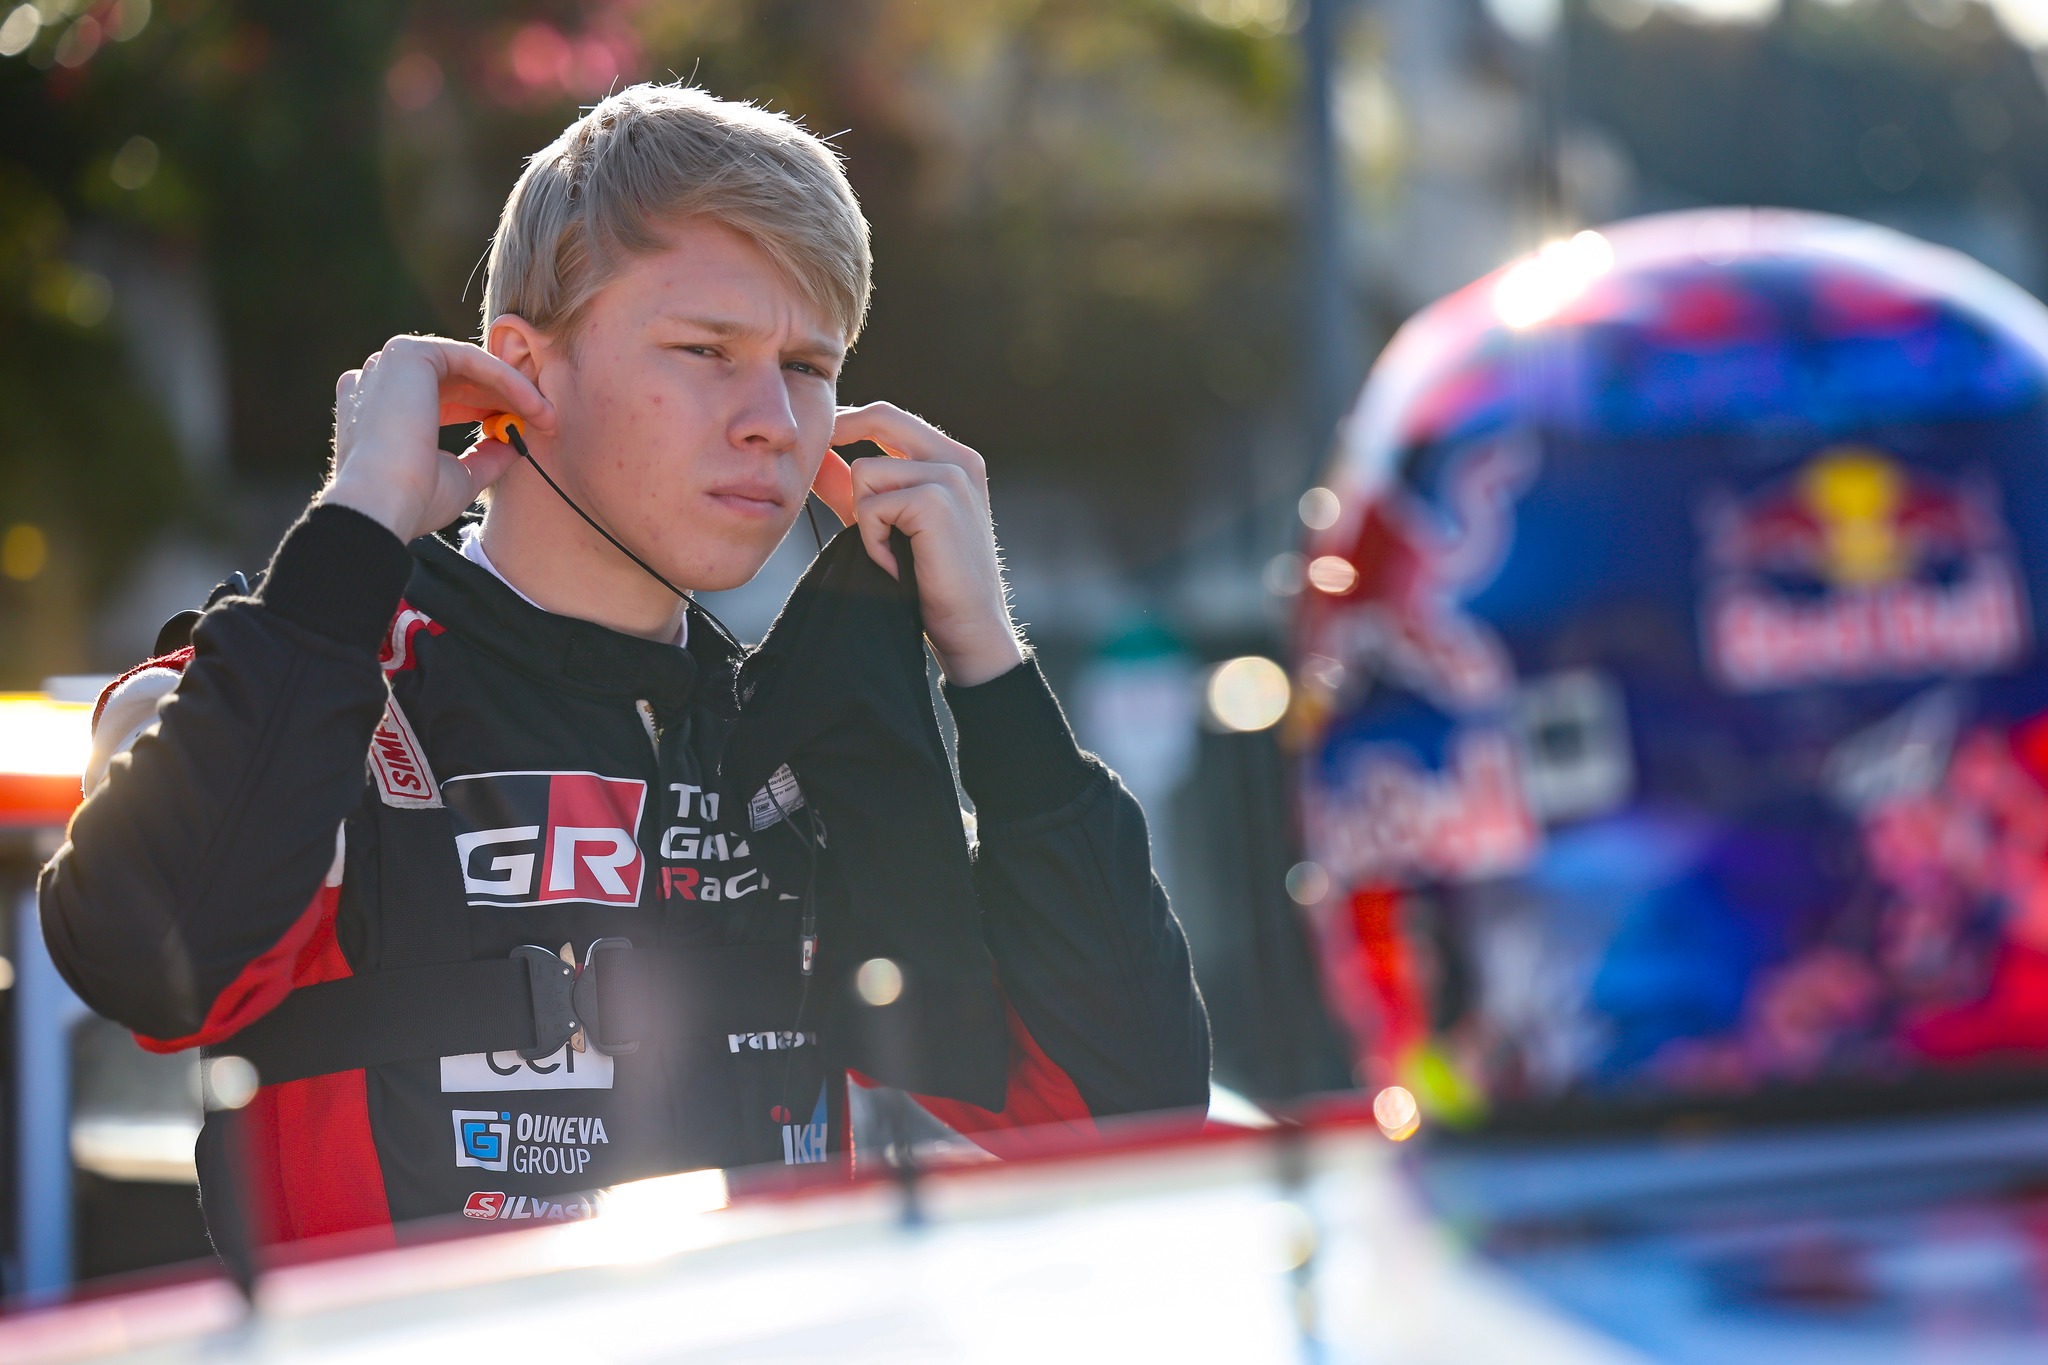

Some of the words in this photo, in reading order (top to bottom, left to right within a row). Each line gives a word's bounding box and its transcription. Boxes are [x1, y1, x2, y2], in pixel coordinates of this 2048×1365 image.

[455, 825, 637, 896] GR
[516, 1112, 610, 1145] OUNEVA
[512, 1144, 592, 1175] GROUP
